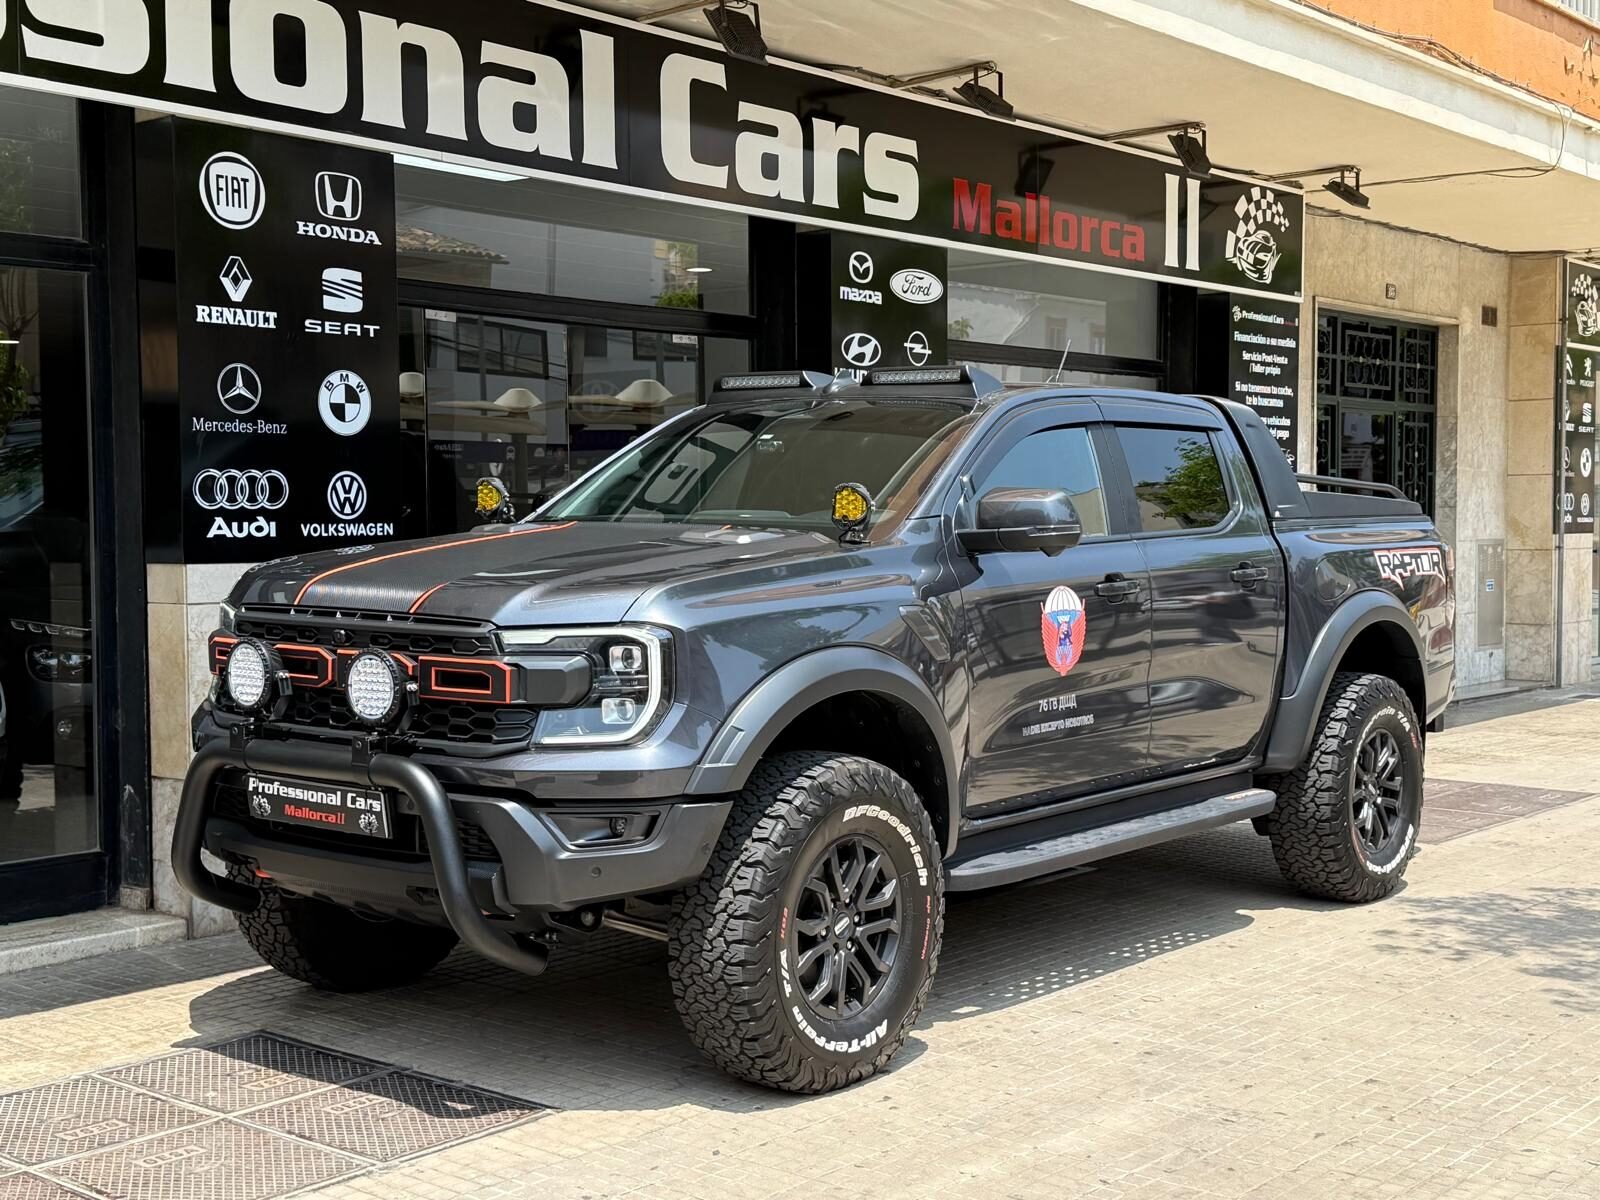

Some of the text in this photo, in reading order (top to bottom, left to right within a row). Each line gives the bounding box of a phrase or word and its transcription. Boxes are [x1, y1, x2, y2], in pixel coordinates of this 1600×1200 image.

[0, 0, 619, 170] sional
[660, 52, 919, 221] Cars
[953, 176, 1145, 263] Mallorca
[216, 174, 250, 210] FIAT
[296, 220, 382, 246] HONDA
[901, 273, 933, 297] Ford
[196, 305, 278, 329] RENAULT
[1242, 310, 1273, 323] Professional
[1273, 314, 1285, 325] Cars
[304, 319, 380, 338] SEAT
[1242, 350, 1261, 362] Servicio
[324, 373, 366, 394] BMW
[1248, 383, 1271, 394] tenemos
[1258, 395, 1283, 408] buscamos
[192, 416, 287, 434] Mercedes-Benz
[1276, 429, 1290, 440] pago
[206, 516, 277, 538] Audi
[301, 523, 394, 537] VOLKSWAGEN
[1374, 551, 1446, 590] RAPTOR
[1038, 699, 1048, 712] 76
[248, 777, 381, 812] Professional Cars
[843, 804, 928, 887] BFGoodrich
[792, 1005, 889, 1054] All-Terrain
